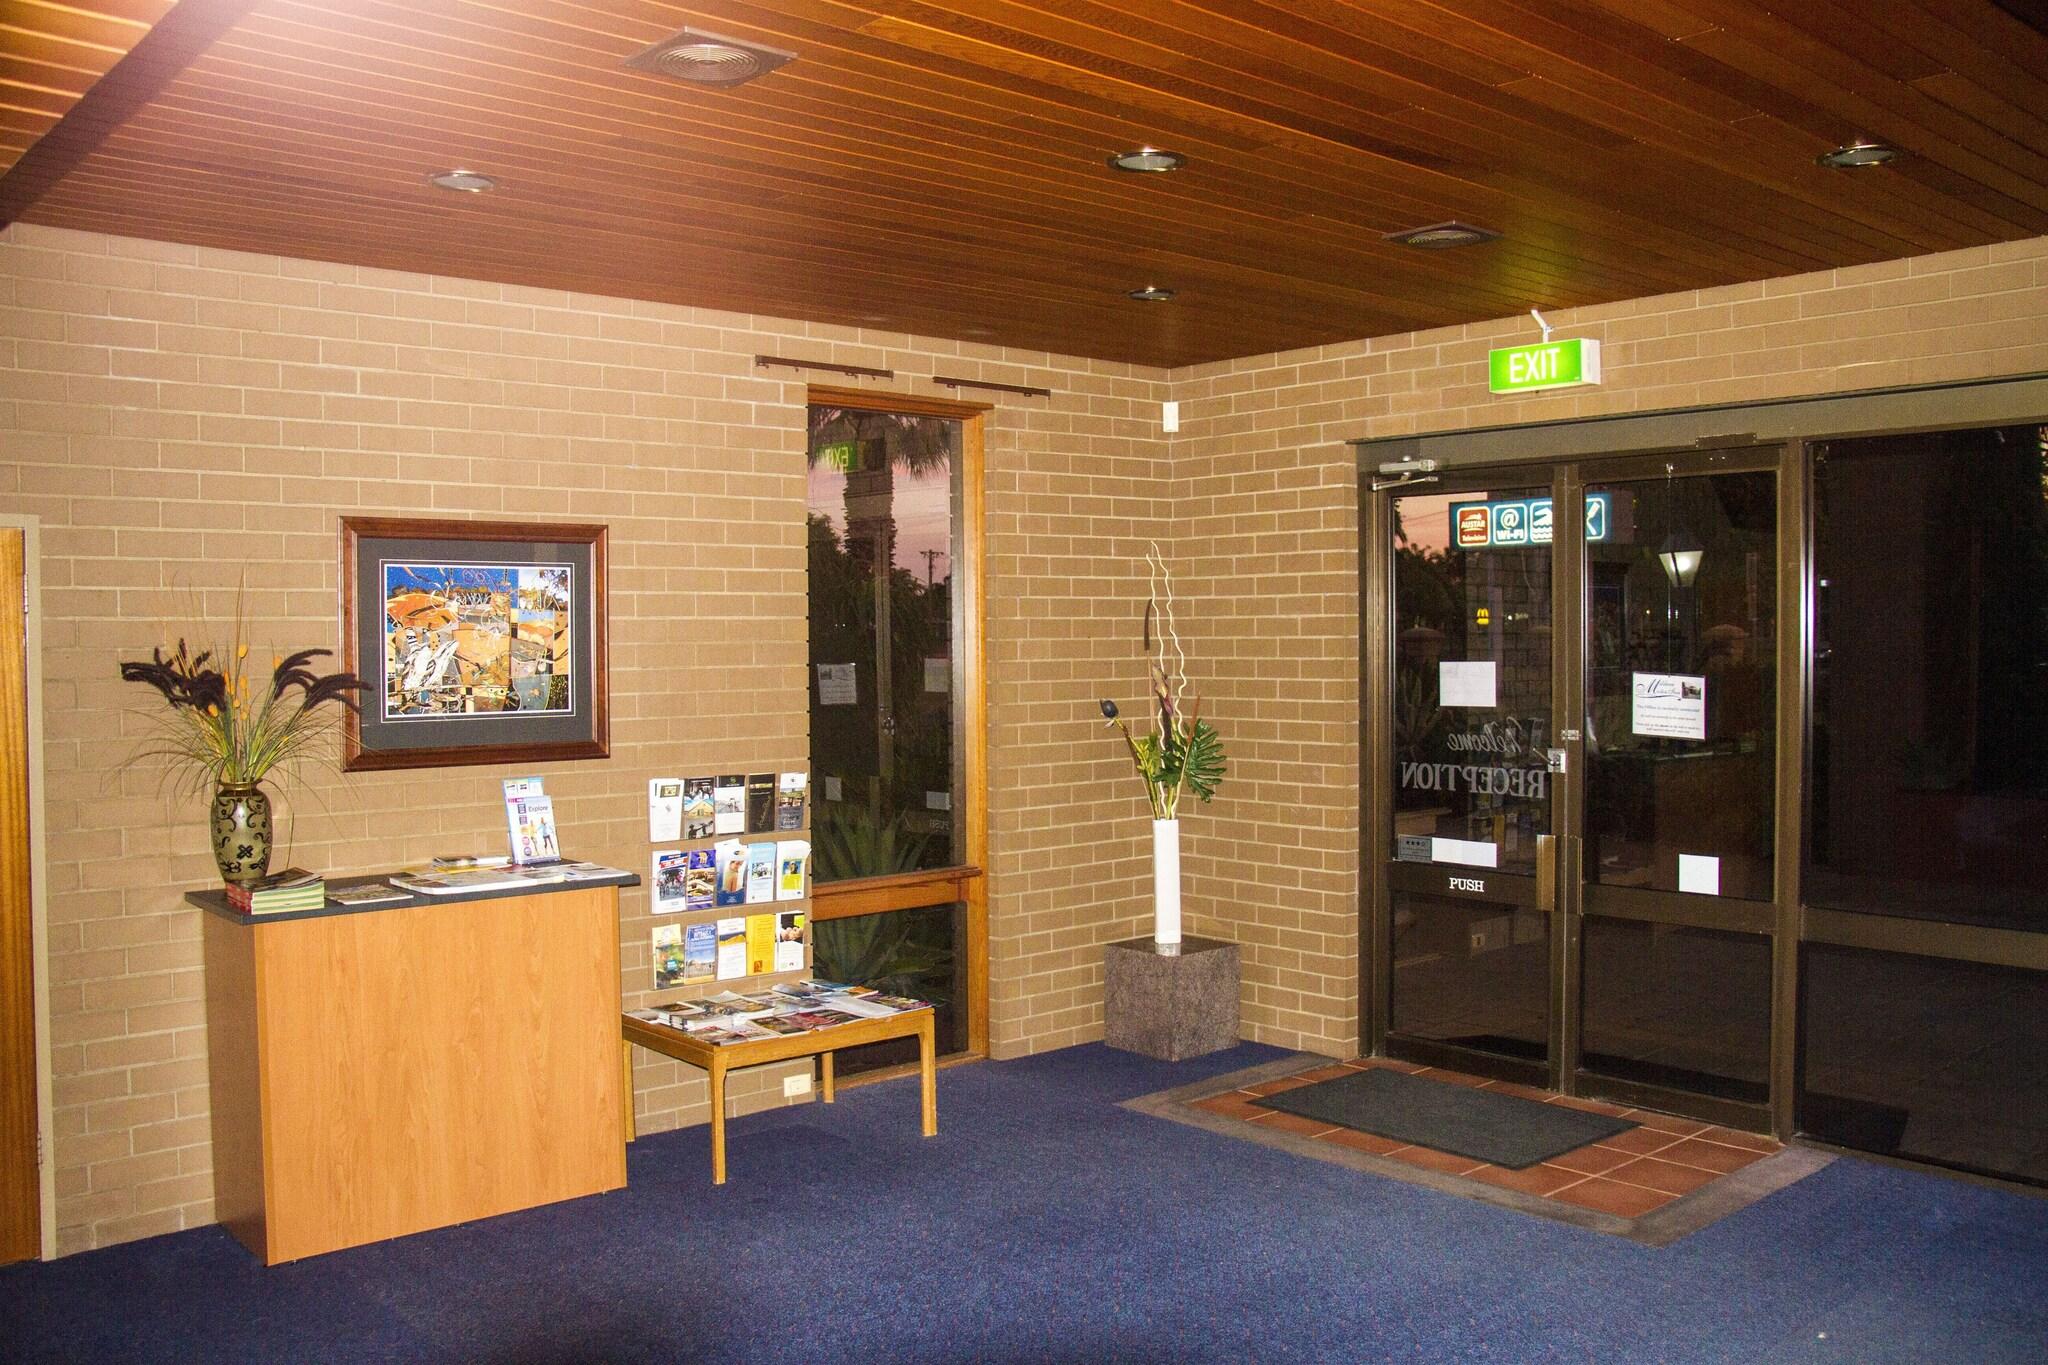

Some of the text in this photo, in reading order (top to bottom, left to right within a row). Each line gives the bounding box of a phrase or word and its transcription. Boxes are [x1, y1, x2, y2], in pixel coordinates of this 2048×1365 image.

[1509, 347, 1561, 384] EXIT
[1461, 519, 1486, 529] AUSTAR
[1449, 877, 1485, 892] PUSH
